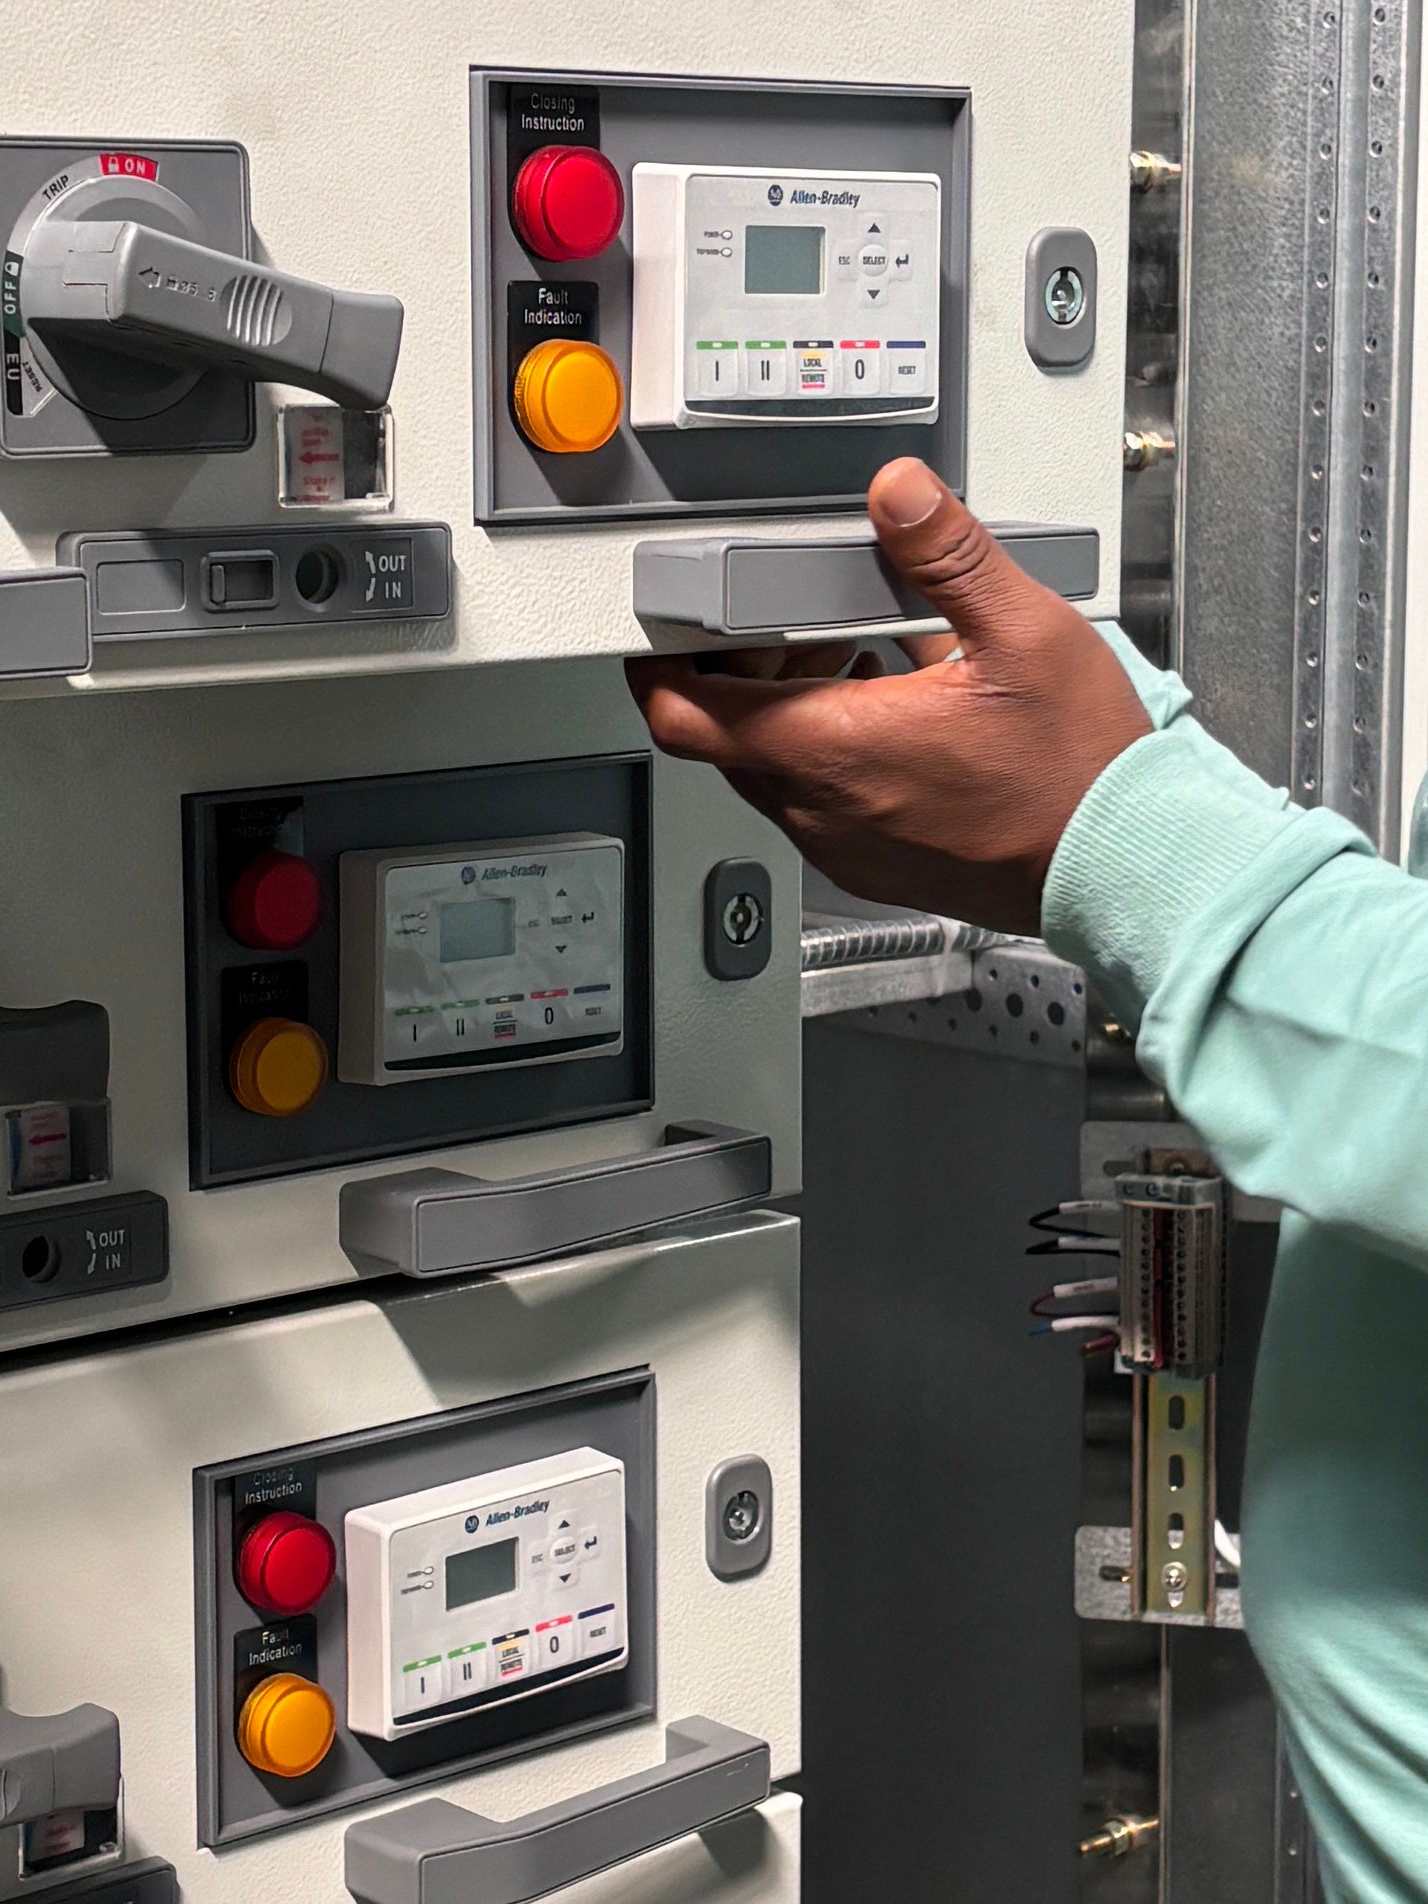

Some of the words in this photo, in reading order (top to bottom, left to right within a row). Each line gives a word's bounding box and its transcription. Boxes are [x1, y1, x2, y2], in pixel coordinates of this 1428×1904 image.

[530, 93, 575, 114] Closing
[521, 114, 585, 132] Instruction
[124, 158, 147, 175] ON
[42, 174, 70, 201] TRIP
[790, 190, 861, 209] Allen-Bradley
[862, 255, 886, 267] SELECT
[4, 280, 18, 315] OFF
[537, 288, 569, 305] Fault
[524, 309, 582, 327] Indication
[803, 357, 823, 368] LOCAL
[21, 360, 43, 392] RESET
[378, 555, 406, 573] OUT
[385, 581, 403, 599] IN
[482, 862, 548, 880] Allen-Bradley
[99, 1229, 126, 1247] OUT
[105, 1252, 121, 1269] IN
[245, 1480, 303, 1505] Instruction
[486, 1498, 550, 1528] Allen-Bradley
[262, 1628, 290, 1645] Fault
[249, 1641, 303, 1666] Indication
[501, 1646, 520, 1658] LOCAL
